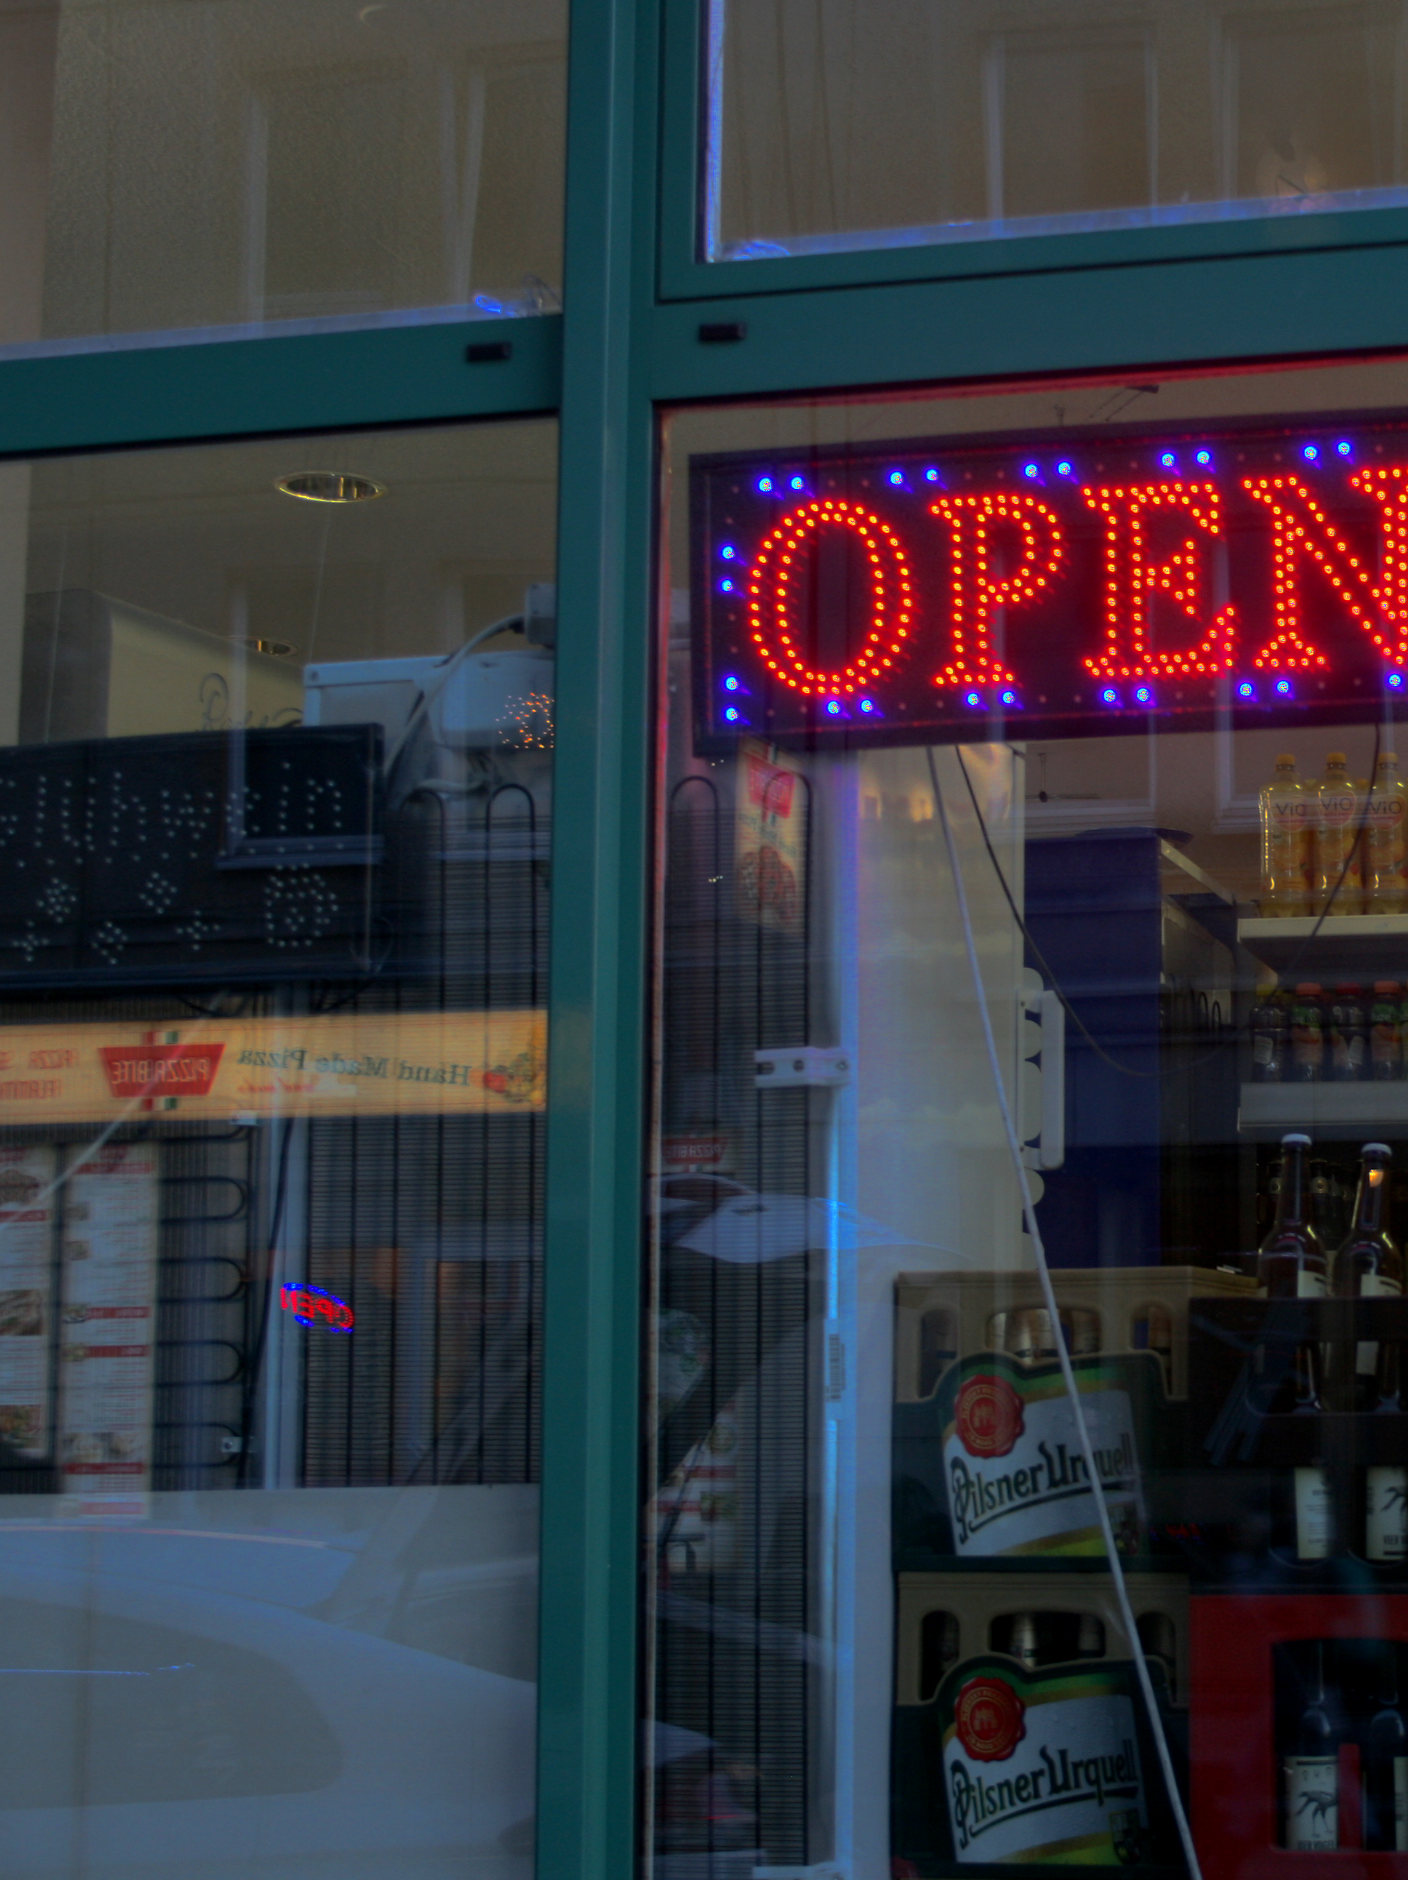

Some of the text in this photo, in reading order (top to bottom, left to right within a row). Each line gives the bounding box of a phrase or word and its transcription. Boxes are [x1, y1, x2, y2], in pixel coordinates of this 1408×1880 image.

[950, 1456, 1044, 1545] Pilsner
[950, 1738, 1139, 1850] Pilsner Urquell
